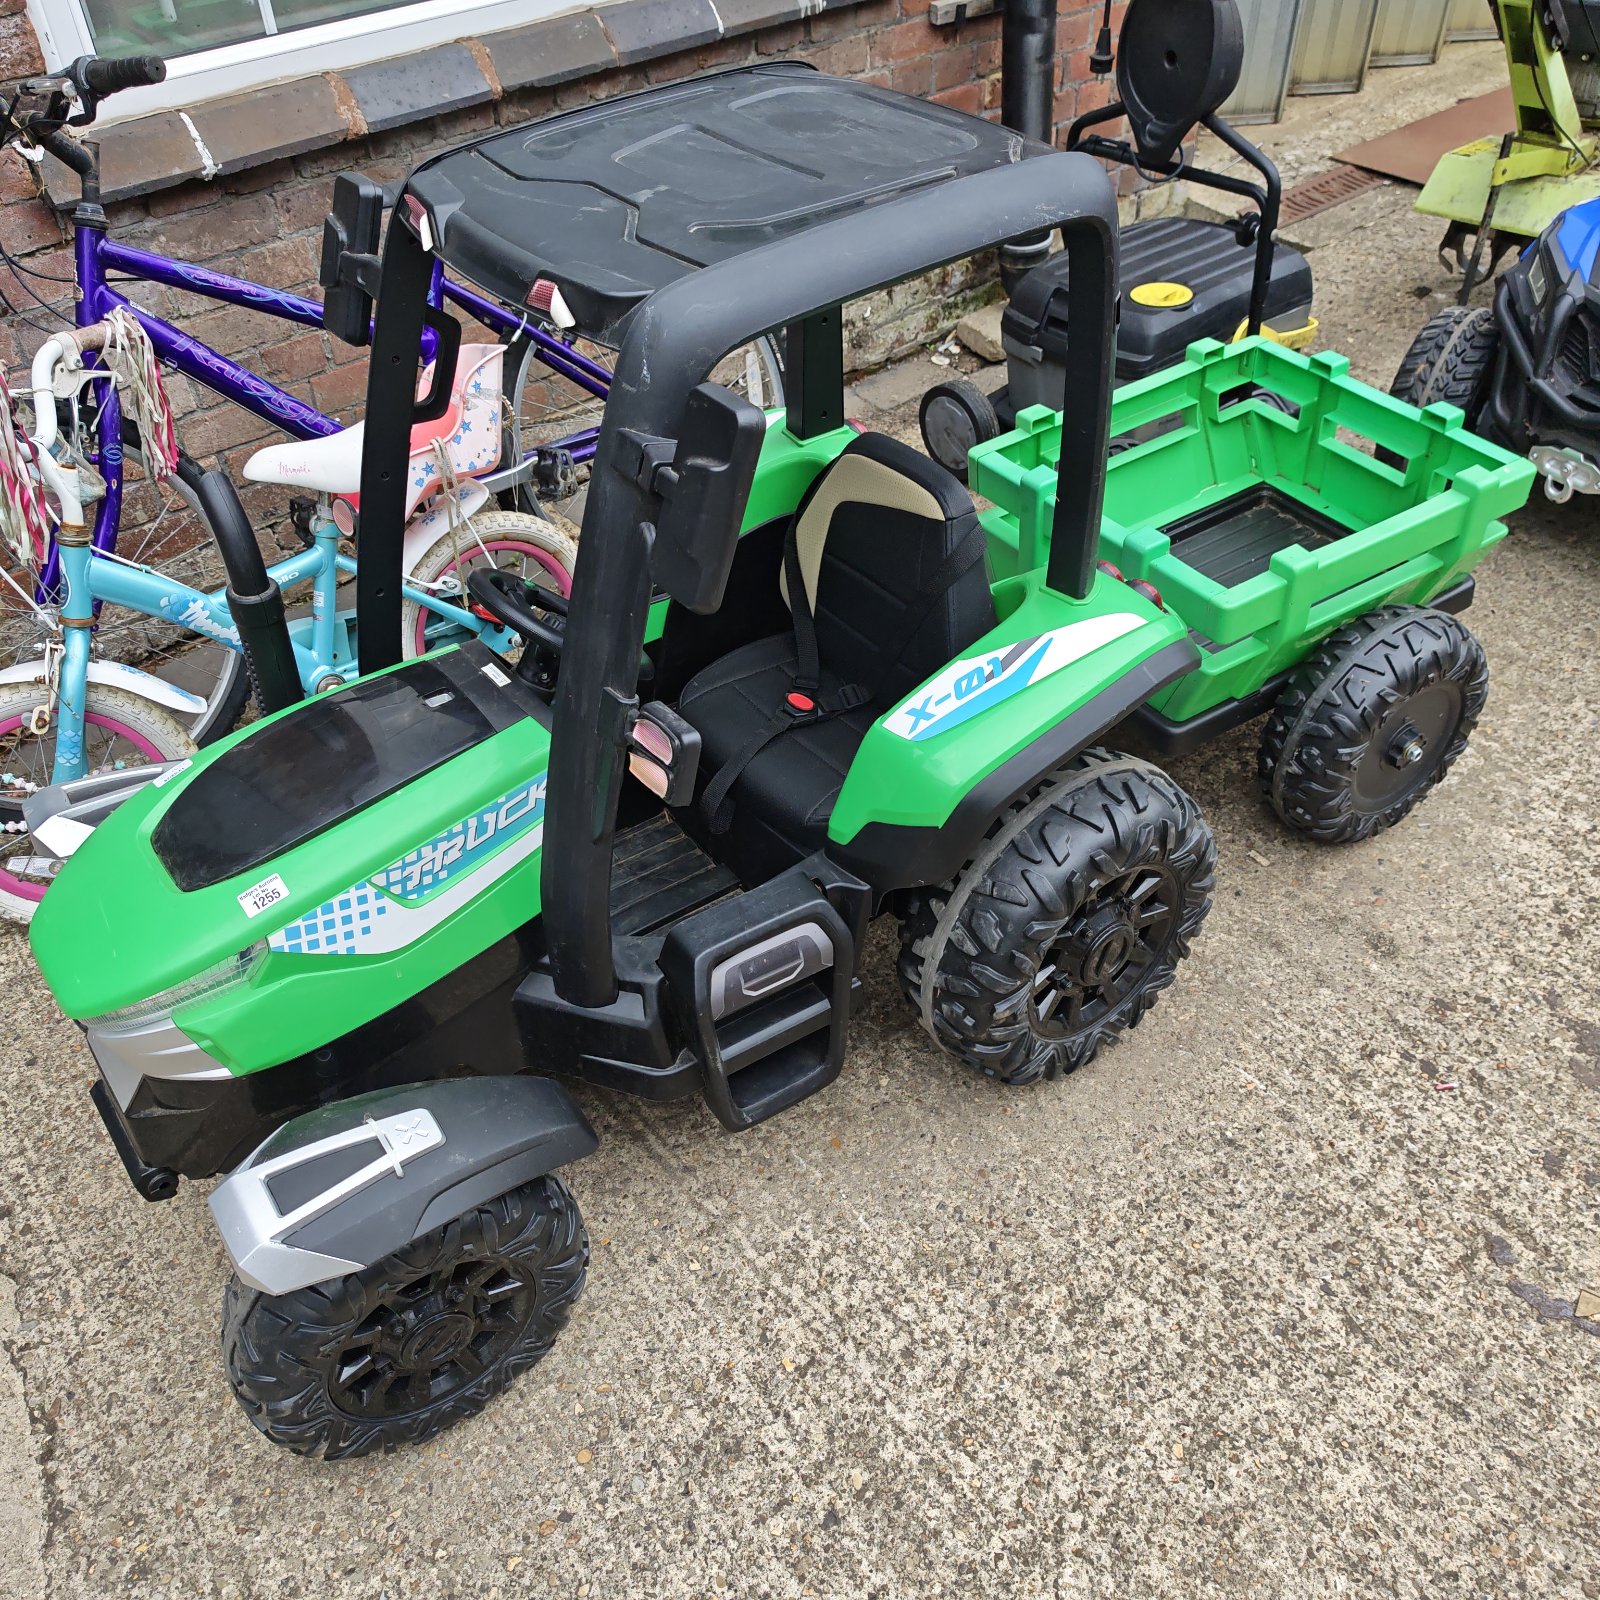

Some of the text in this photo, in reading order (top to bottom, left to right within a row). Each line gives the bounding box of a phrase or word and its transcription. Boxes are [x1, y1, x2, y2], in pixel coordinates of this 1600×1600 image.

[171, 334, 334, 435] Raleigh
[904, 656, 1003, 736] X-01
[252, 887, 281, 910] 1255
